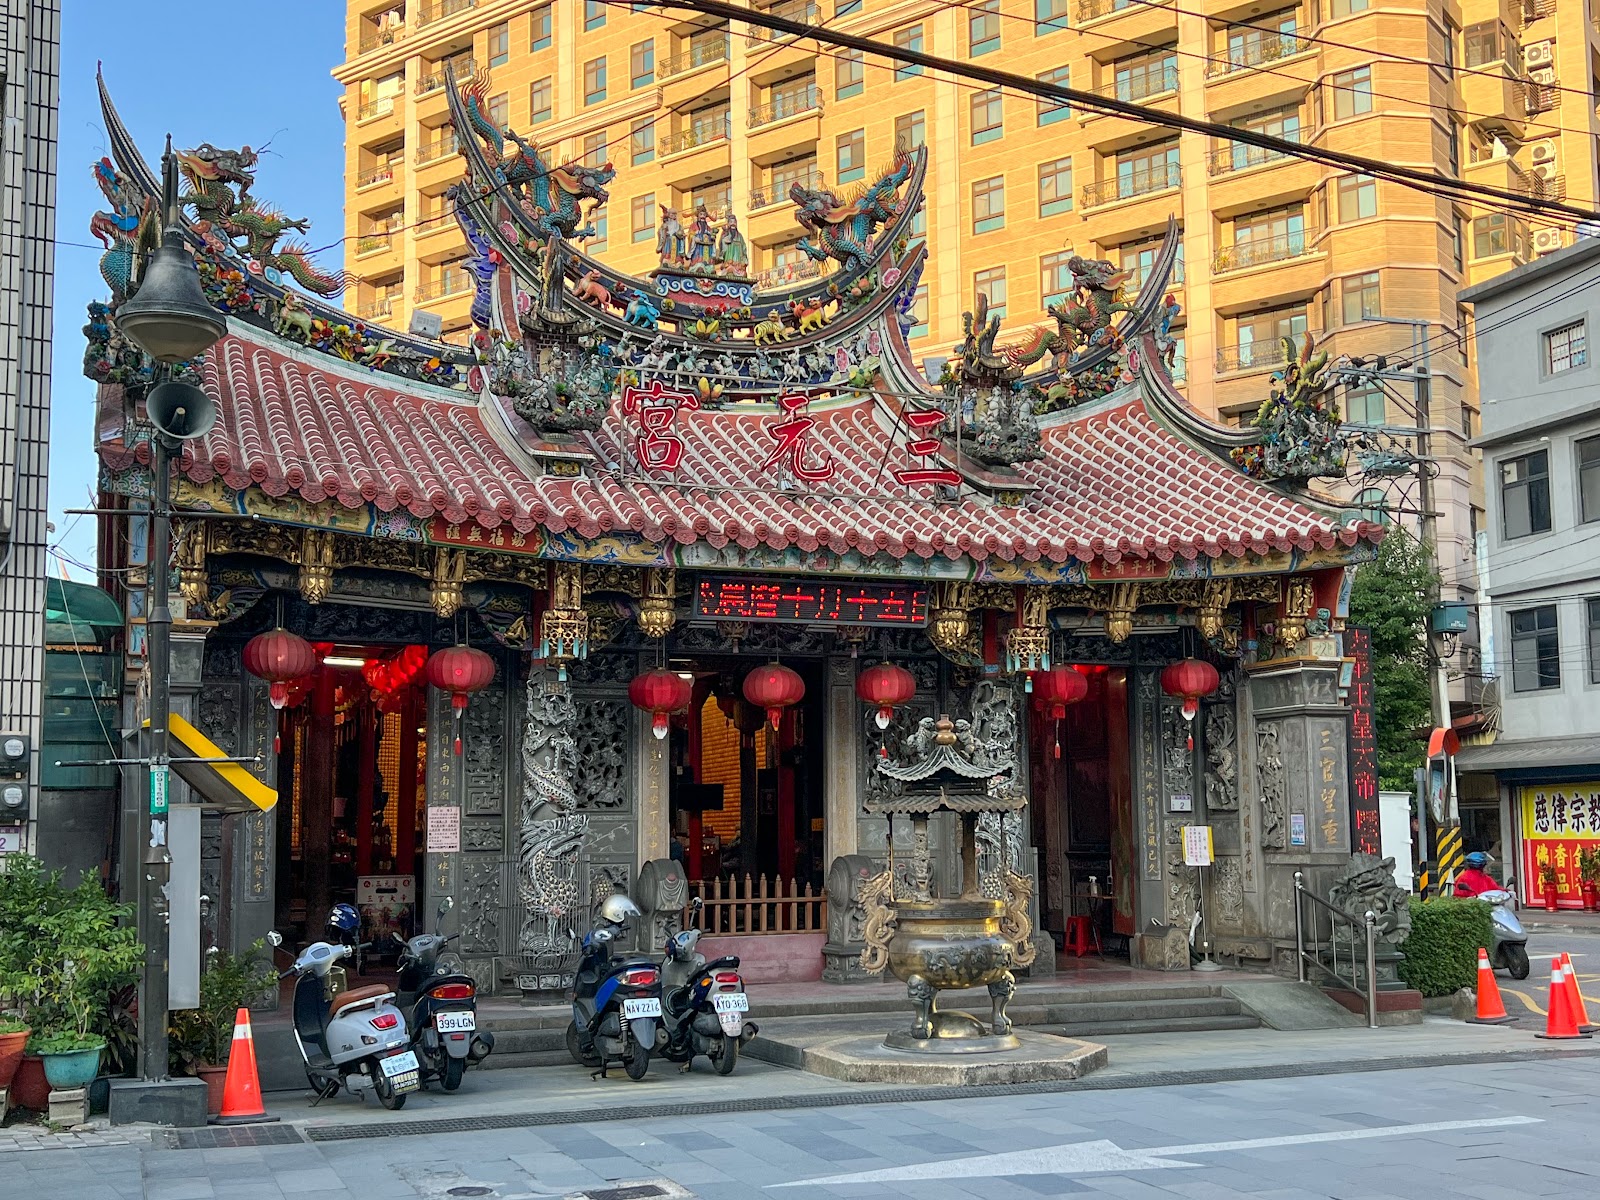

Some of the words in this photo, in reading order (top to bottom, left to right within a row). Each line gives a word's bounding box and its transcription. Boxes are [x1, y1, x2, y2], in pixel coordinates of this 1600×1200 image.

[624, 380, 963, 486] 三元宮
[1319, 730, 1338, 845] 三官望重
[1535, 793, 1600, 833] 慈律宗教
[439, 1017, 474, 1029] 399-LGN
